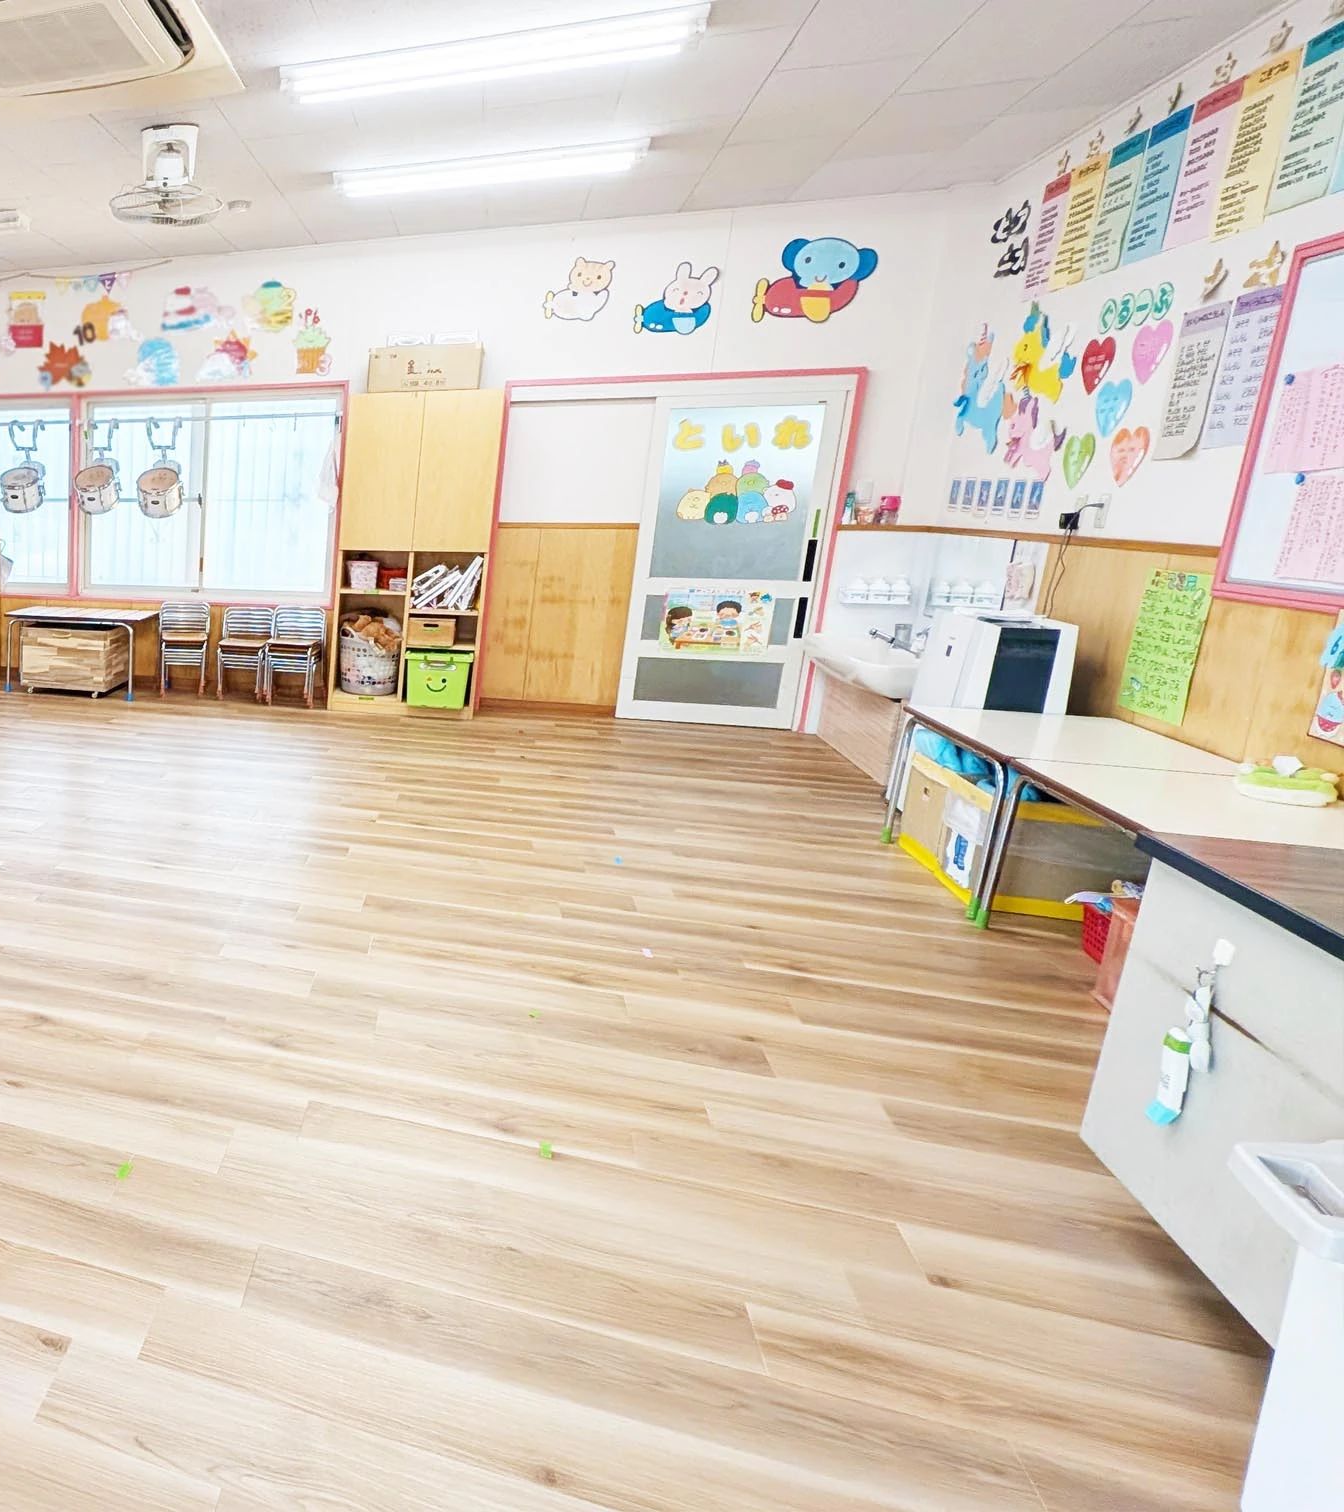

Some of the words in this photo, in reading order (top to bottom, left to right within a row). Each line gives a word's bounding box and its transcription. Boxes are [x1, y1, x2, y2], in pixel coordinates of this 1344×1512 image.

[73, 321, 97, 346] 10
[674, 415, 811, 452] といれ
